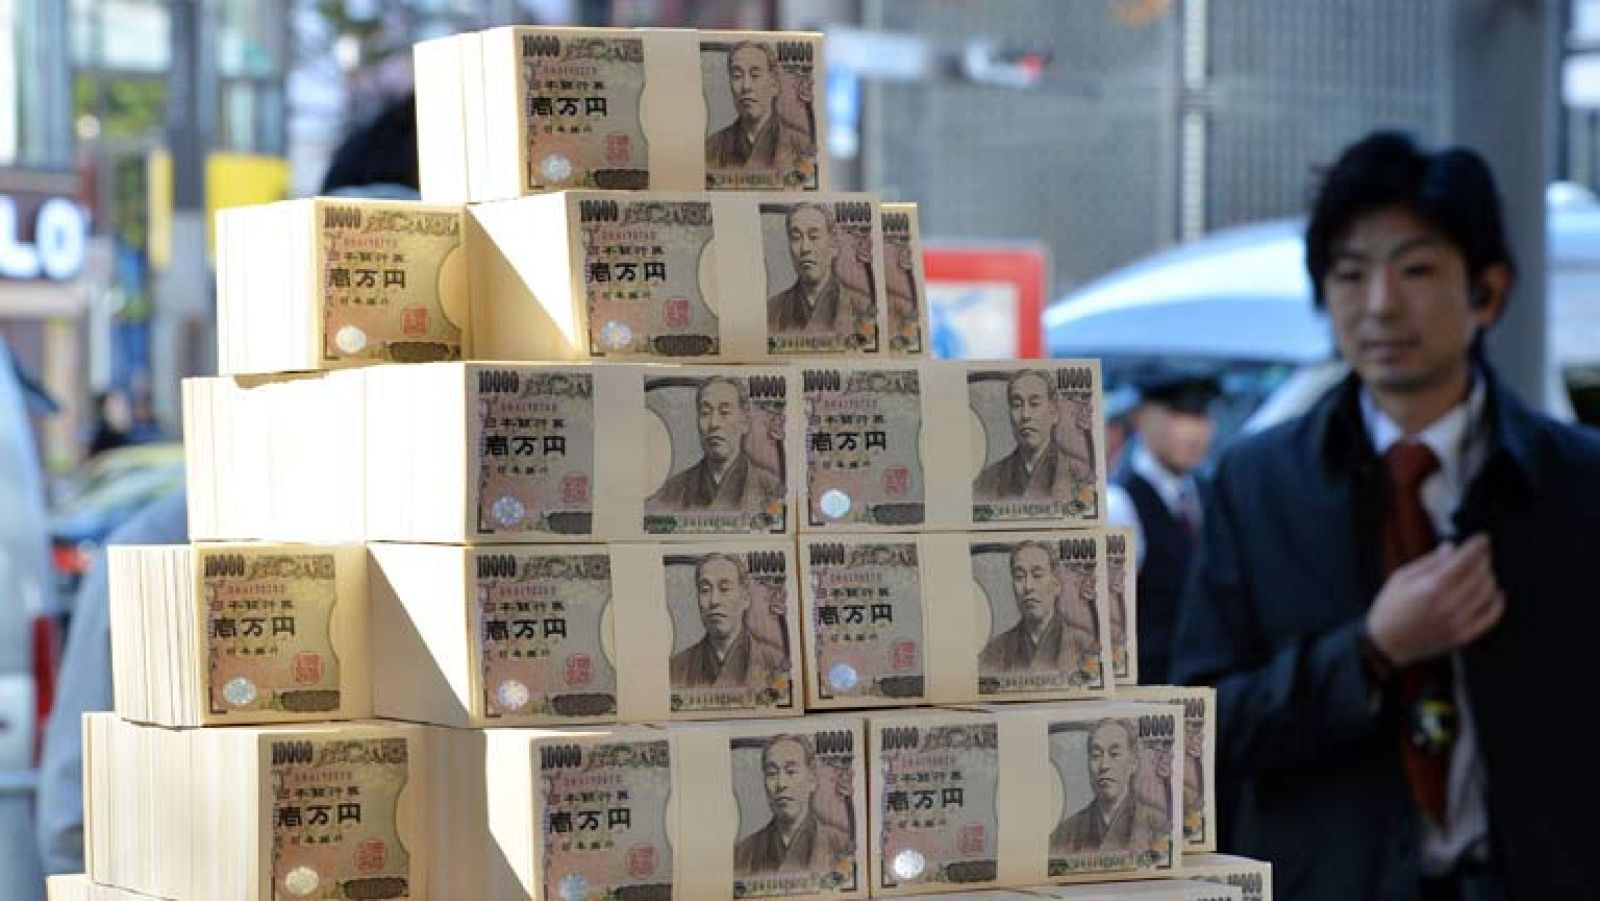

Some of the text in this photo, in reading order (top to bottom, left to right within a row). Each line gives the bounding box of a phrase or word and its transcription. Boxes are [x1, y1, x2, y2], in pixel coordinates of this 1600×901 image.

[523, 35, 559, 56] 10000
[777, 41, 813, 61] 10000
[324, 206, 361, 228] 10000
[580, 200, 618, 221] 10000
[835, 202, 871, 223] 10000
[881, 212, 909, 232] 0000
[479, 371, 519, 392] 10000
[750, 375, 786, 397] 10000
[802, 369, 840, 392] 10000
[1057, 367, 1092, 388] 10000
[809, 543, 844, 565] 10000
[1060, 537, 1096, 560] 10000
[1106, 534, 1125, 555] 000
[204, 554, 245, 576] 10000
[477, 555, 516, 578] 10000
[748, 551, 785, 573] 10000
[1167, 697, 1205, 718] 000
[1139, 715, 1175, 736] 10000
[816, 730, 853, 753] 10000
[881, 726, 919, 751] 10000
[272, 741, 313, 764] 10000
[540, 744, 582, 769] 10000
